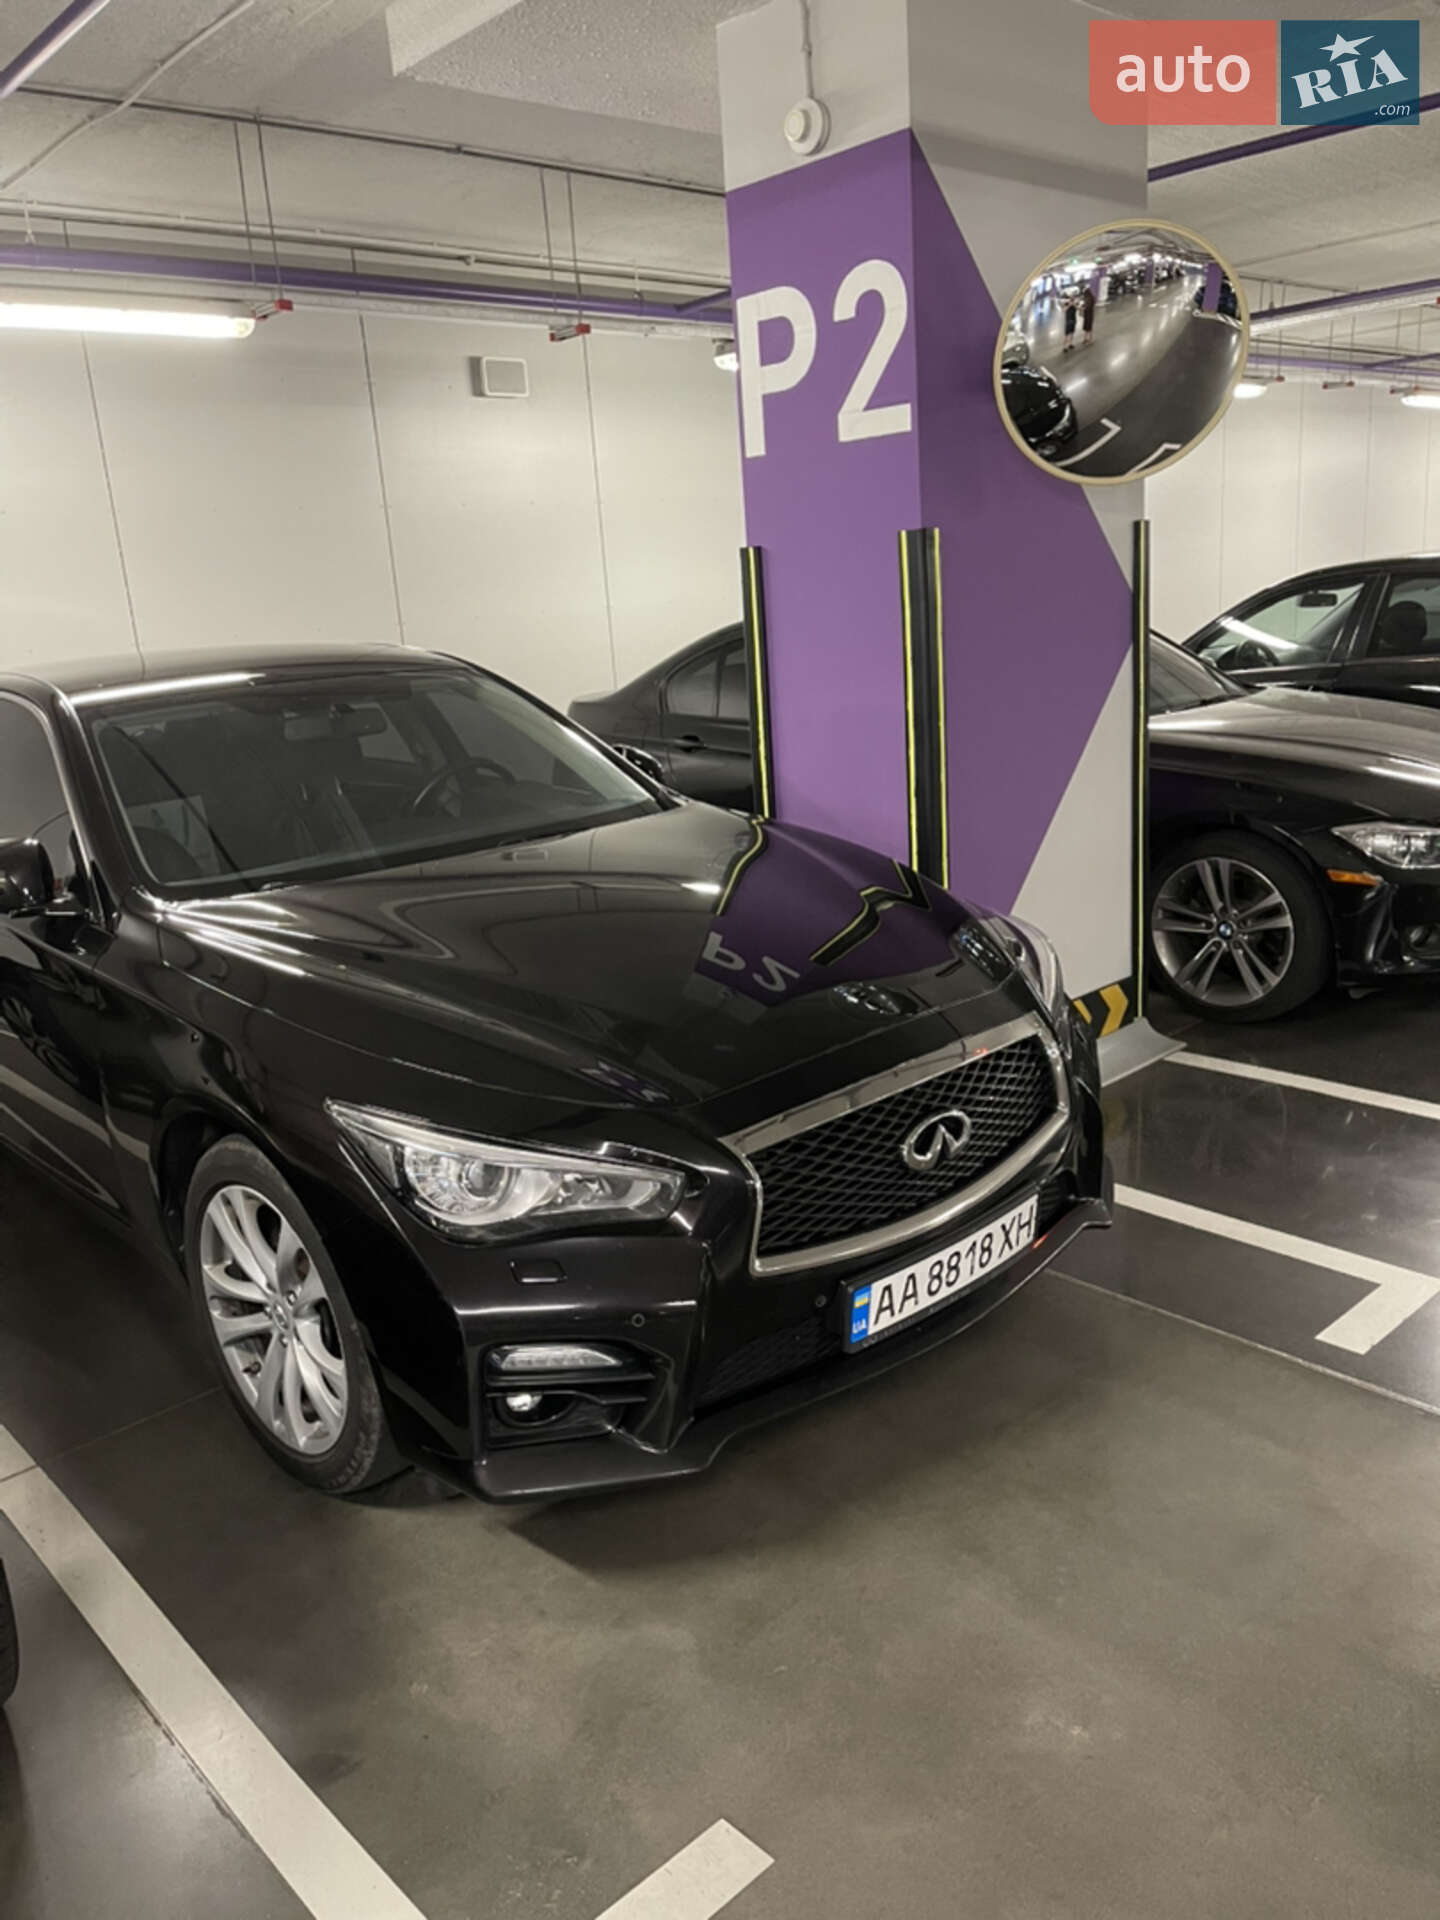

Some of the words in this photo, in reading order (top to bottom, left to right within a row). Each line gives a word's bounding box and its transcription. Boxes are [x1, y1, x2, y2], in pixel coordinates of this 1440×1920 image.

[736, 259, 912, 458] P2
[874, 1273, 918, 1326] AA
[927, 1232, 992, 1296] 8818
[998, 1205, 1034, 1258] XH
